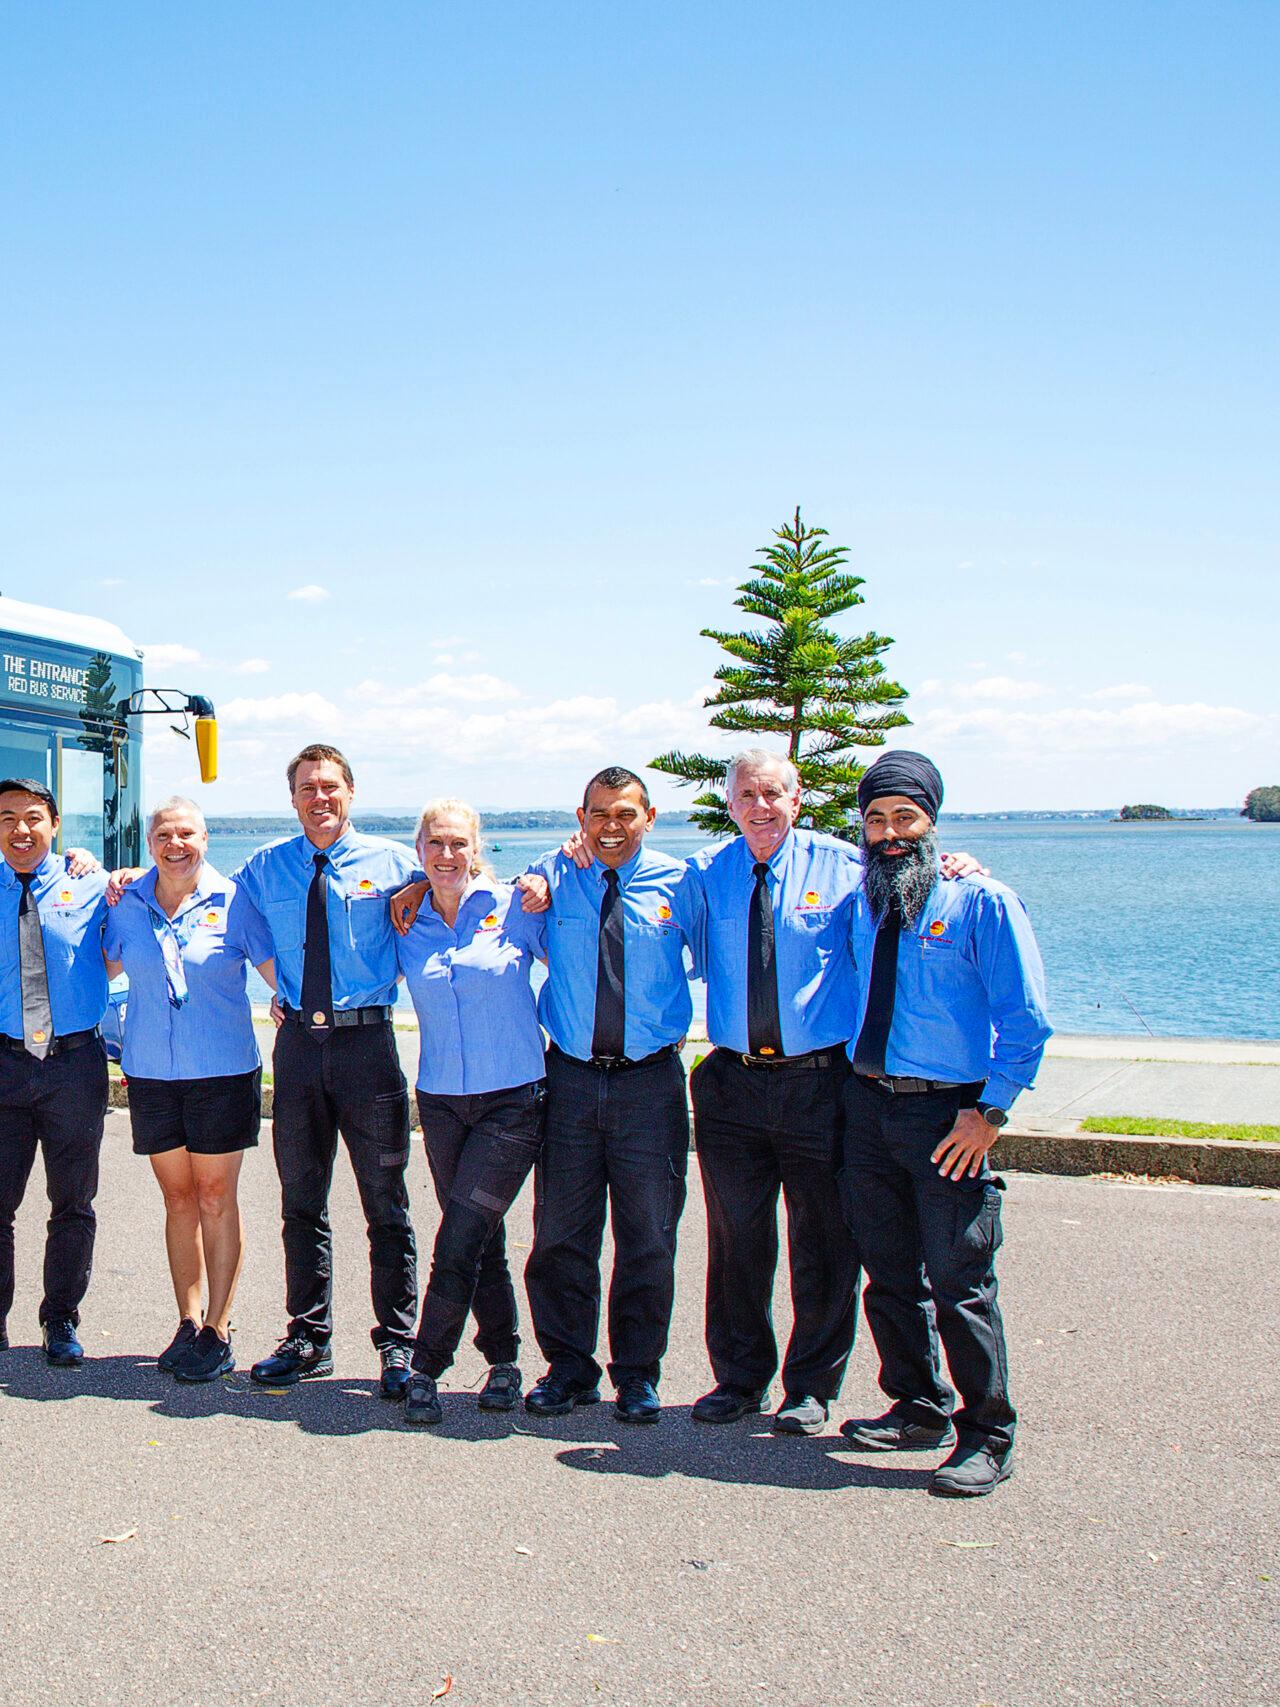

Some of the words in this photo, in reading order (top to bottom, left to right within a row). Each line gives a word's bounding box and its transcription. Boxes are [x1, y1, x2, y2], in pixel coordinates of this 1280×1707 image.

[3, 654, 26, 675] THE
[30, 660, 90, 687] ENTRANCE
[8, 676, 28, 694] RED
[30, 680, 49, 697] BUS
[50, 684, 88, 704] SERVICE
[120, 1002, 128, 1022] 9
